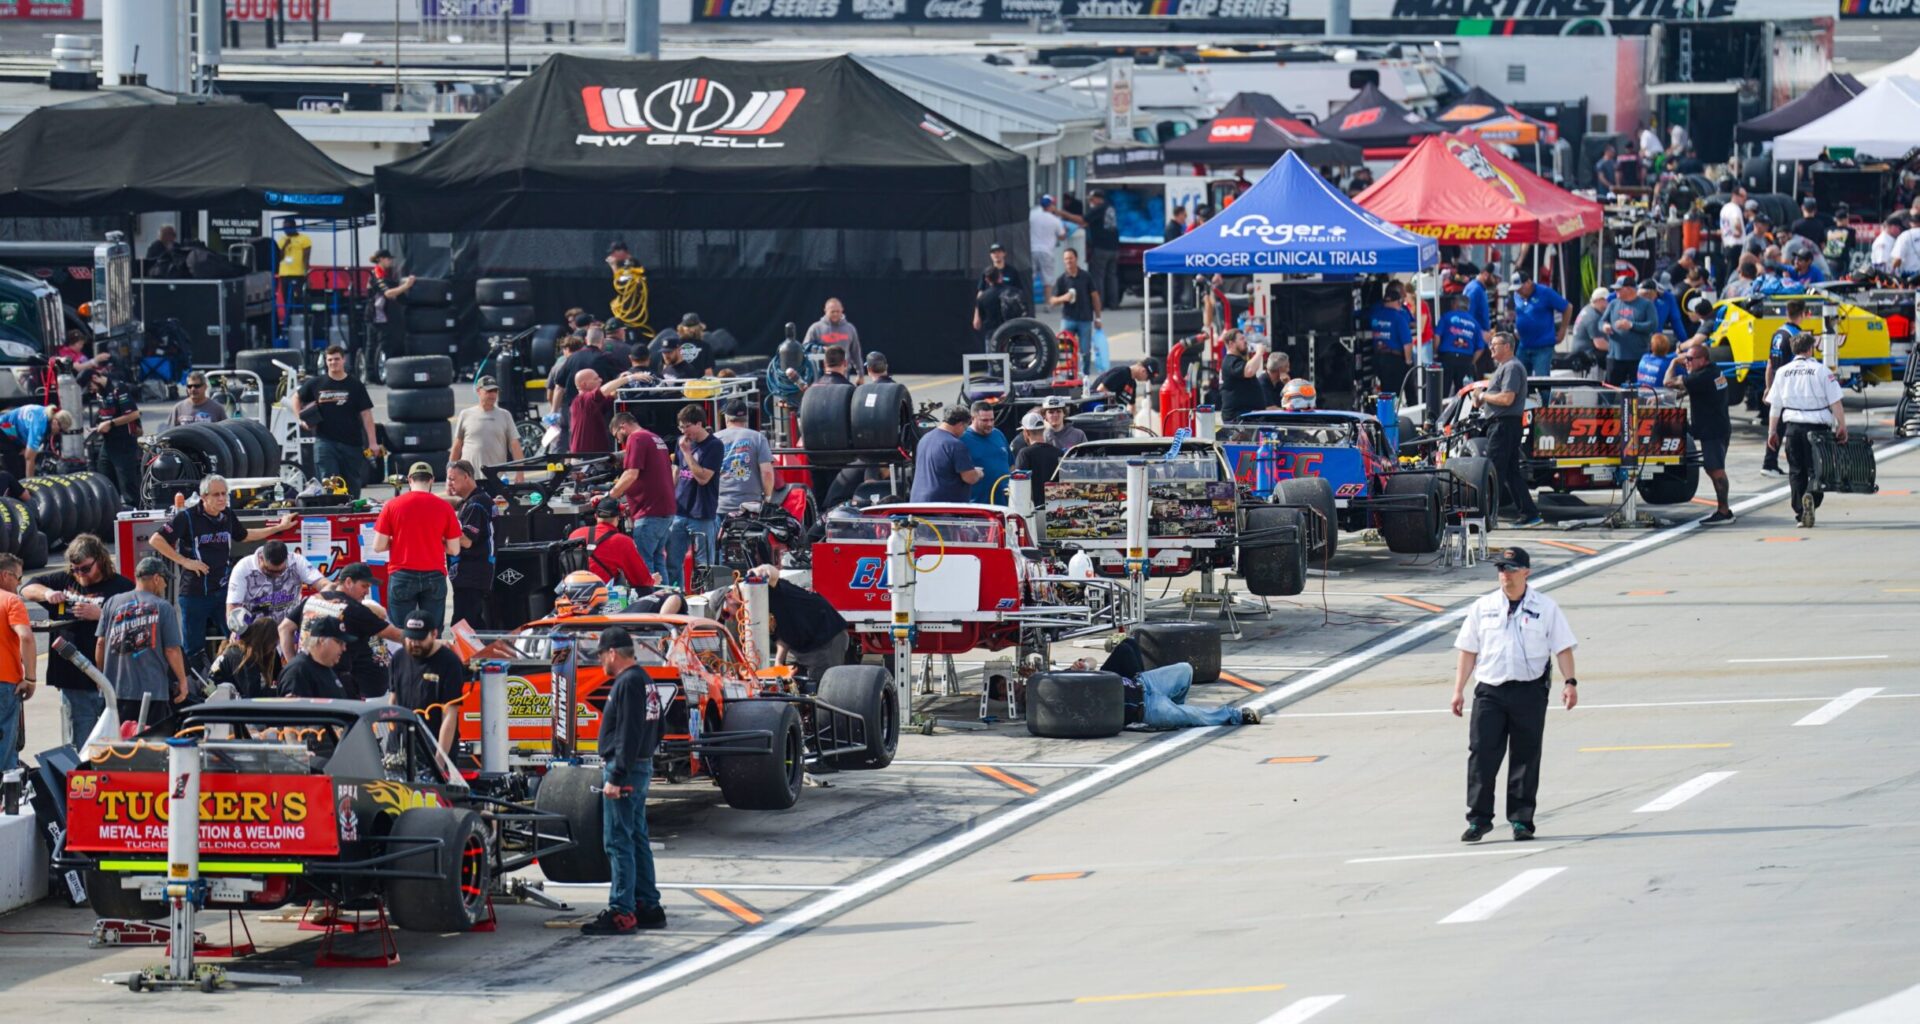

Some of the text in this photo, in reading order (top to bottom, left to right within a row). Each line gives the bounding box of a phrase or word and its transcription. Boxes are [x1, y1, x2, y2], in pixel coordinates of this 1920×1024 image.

[730, 0, 839, 17] CUP SERIES
[1177, 0, 1290, 16] CUP SERIES
[646, 134, 785, 148] GRILL
[212, 219, 259, 228] PUBLIC RELATIONS
[1220, 214, 1325, 245] Kroger
[219, 228, 235, 236] RADIO
[1299, 235, 1346, 243] health
[1185, 250, 1377, 267] KROGER CLINICAL TRIALS
[1784, 368, 1816, 378] OFFICIAL
[1569, 418, 1656, 436] STOE
[1661, 438, 1680, 451] 38
[507, 696, 551, 706] ORIZON
[556, 674, 567, 740] HARTWIG
[69, 775, 98, 799] 95
[99, 826, 305, 839] METAL FABTION & WELDING
